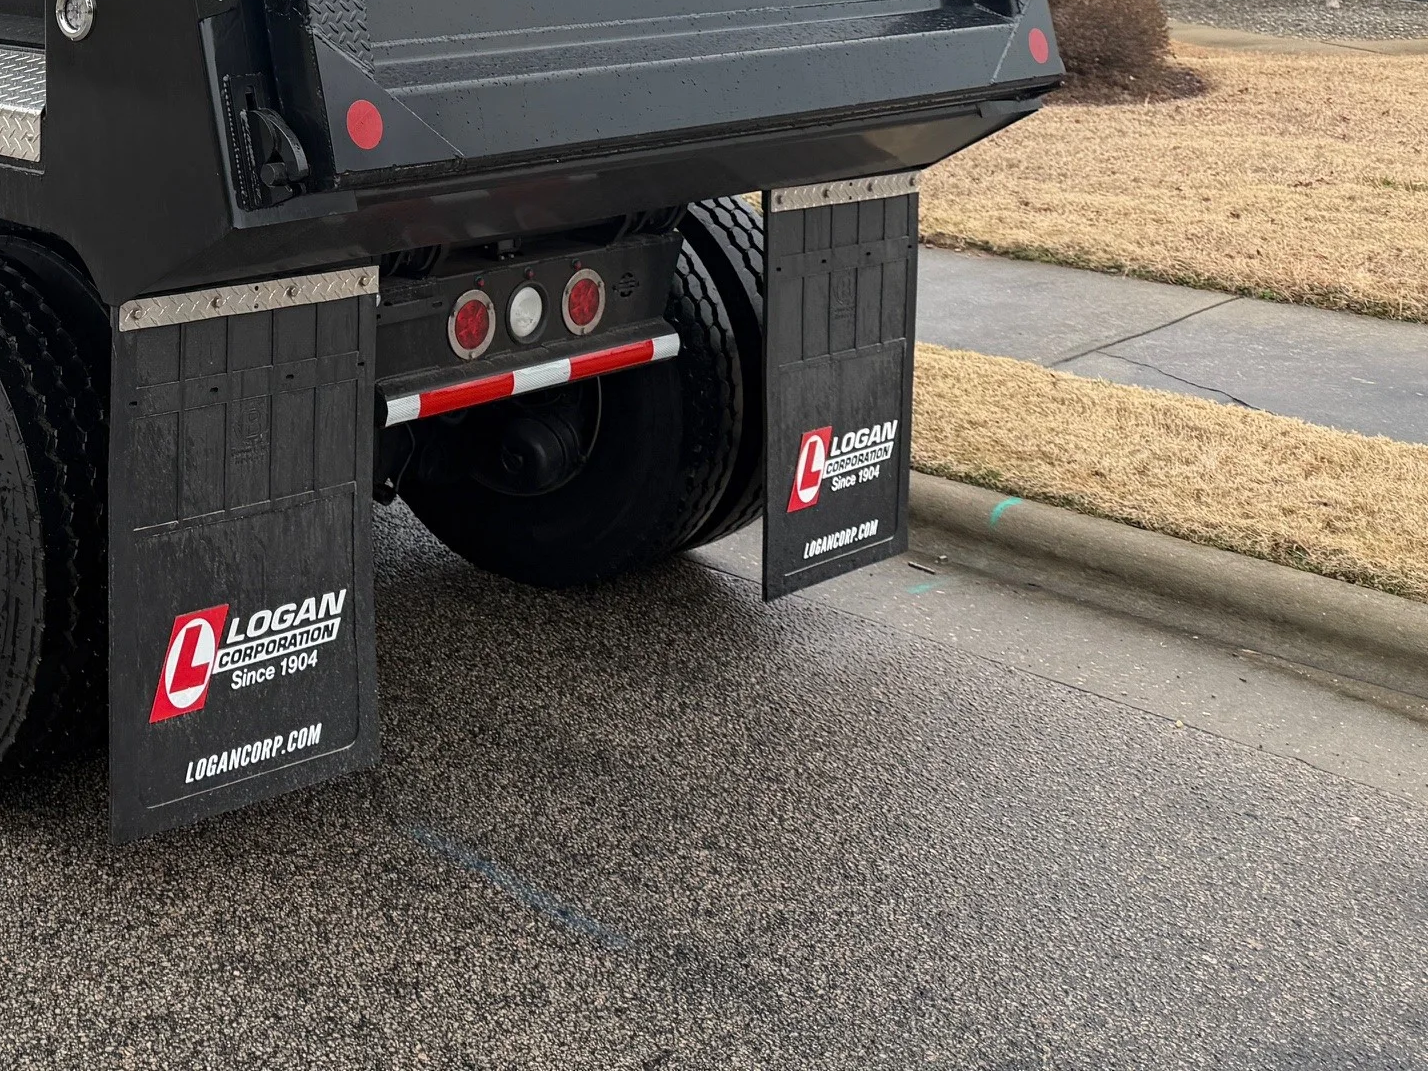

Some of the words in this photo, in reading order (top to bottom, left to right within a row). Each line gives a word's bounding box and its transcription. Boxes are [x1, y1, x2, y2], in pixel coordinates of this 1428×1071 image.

[830, 419, 898, 457] LOGAN
[826, 444, 890, 475] CORPORATION
[831, 475, 856, 492] Since
[858, 465, 880, 484] 1904
[803, 519, 879, 560] LOGANCORP.COM
[226, 589, 347, 644] LOGAN
[218, 622, 335, 668] CORPORATION
[231, 663, 275, 690] Since
[280, 650, 318, 677] 1904
[185, 722, 322, 784] LOGANCORP.COM
